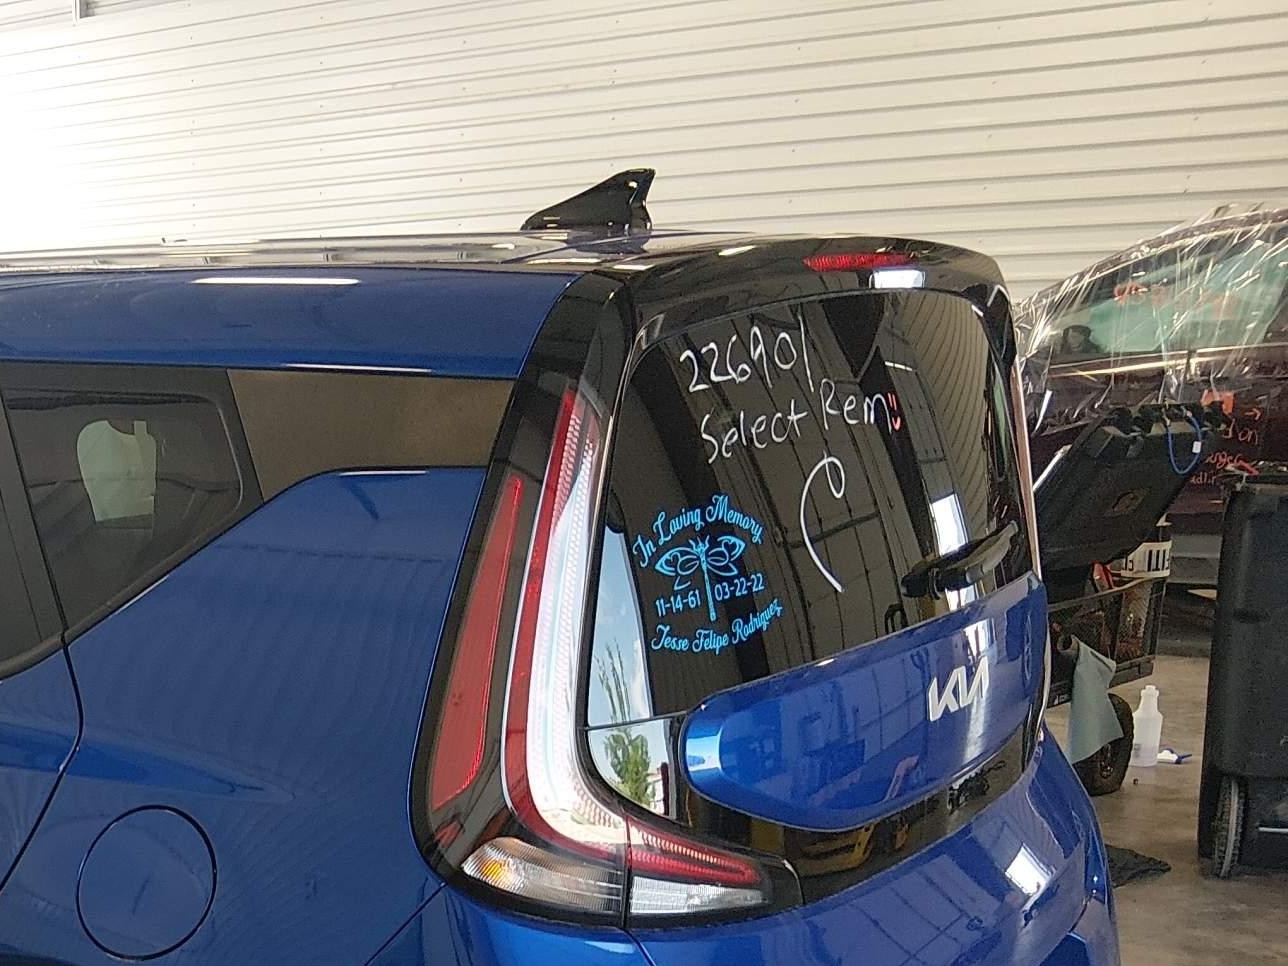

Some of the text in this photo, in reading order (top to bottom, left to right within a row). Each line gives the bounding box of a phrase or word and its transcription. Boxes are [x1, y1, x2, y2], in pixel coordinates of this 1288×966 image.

[679, 314, 814, 393] 226901
[700, 399, 808, 464] Select
[632, 535, 657, 568] In
[705, 494, 763, 545] Memory
[651, 598, 784, 656] Jesse Felipe Rodriguez
[655, 573, 765, 617] 11-14-61 03-22-22
[928, 655, 990, 722] KIA
